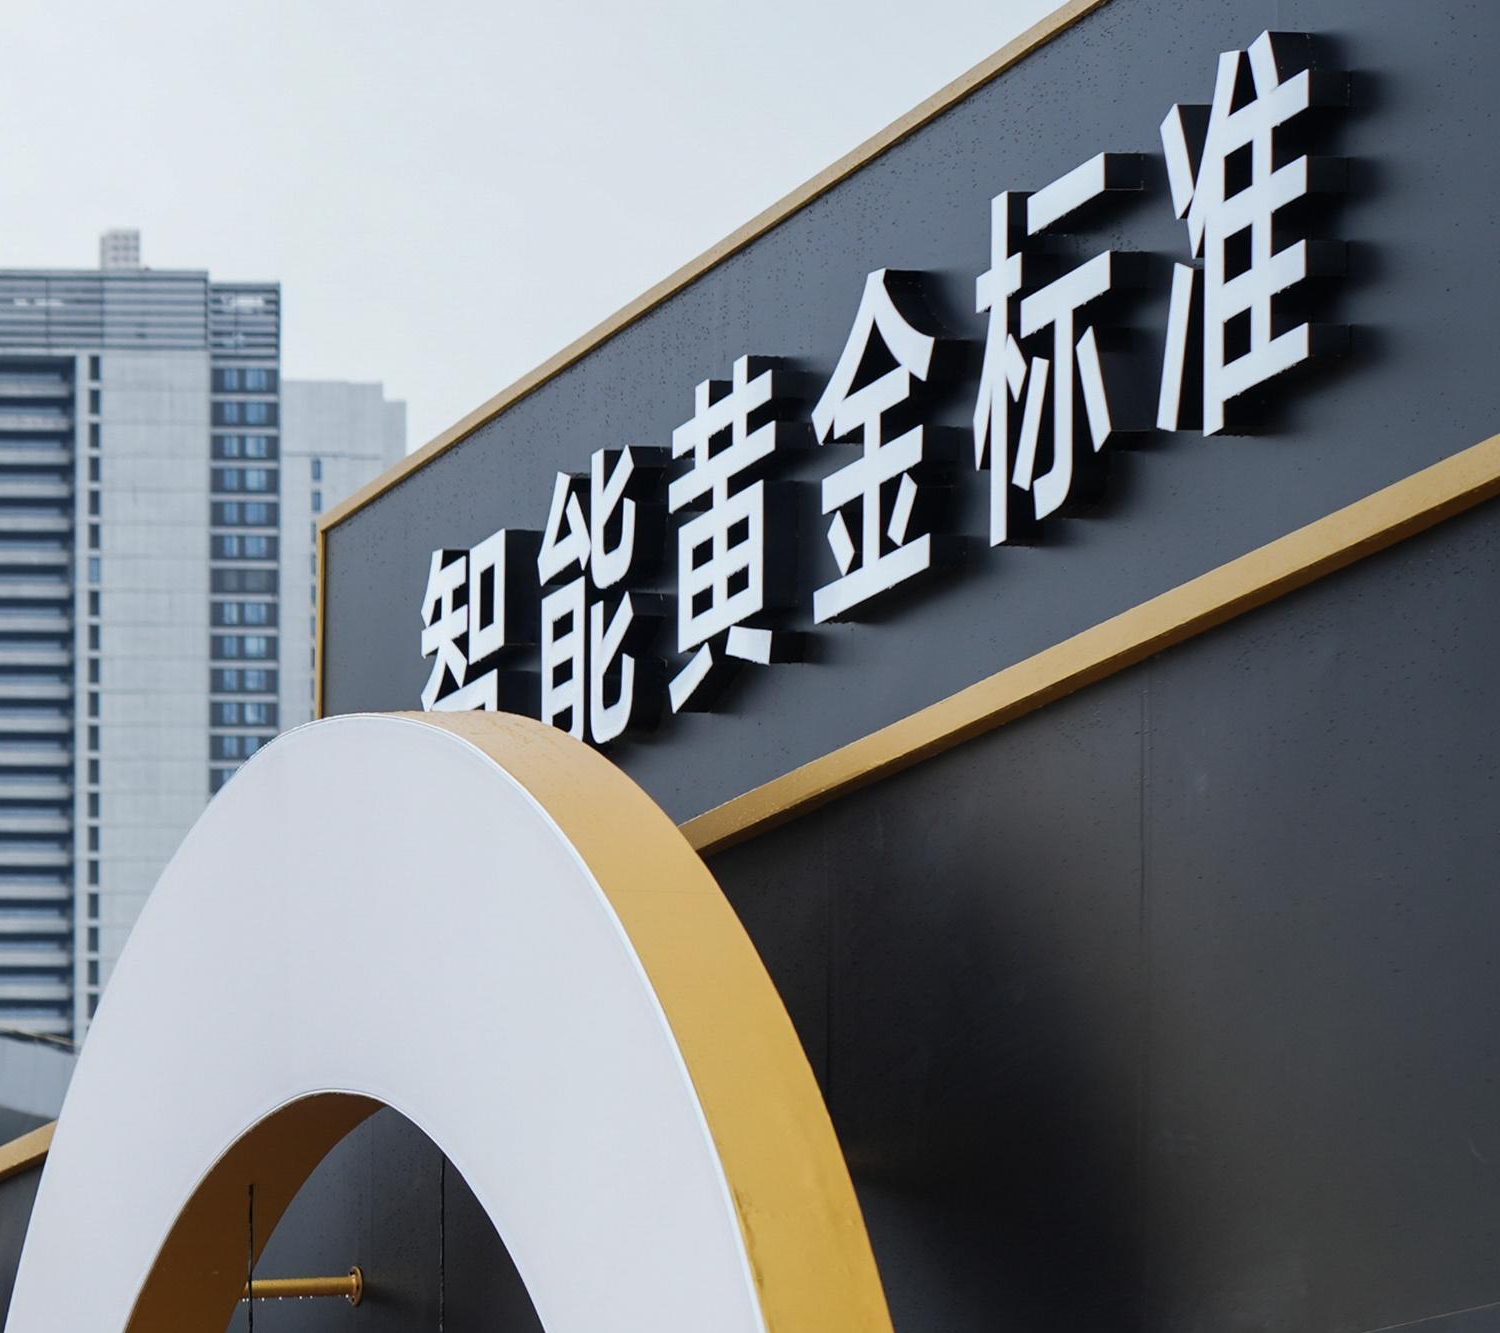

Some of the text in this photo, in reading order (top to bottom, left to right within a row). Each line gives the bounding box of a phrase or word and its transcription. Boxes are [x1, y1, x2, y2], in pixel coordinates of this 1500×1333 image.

[420, 29, 1311, 744] 智能黄金标准
